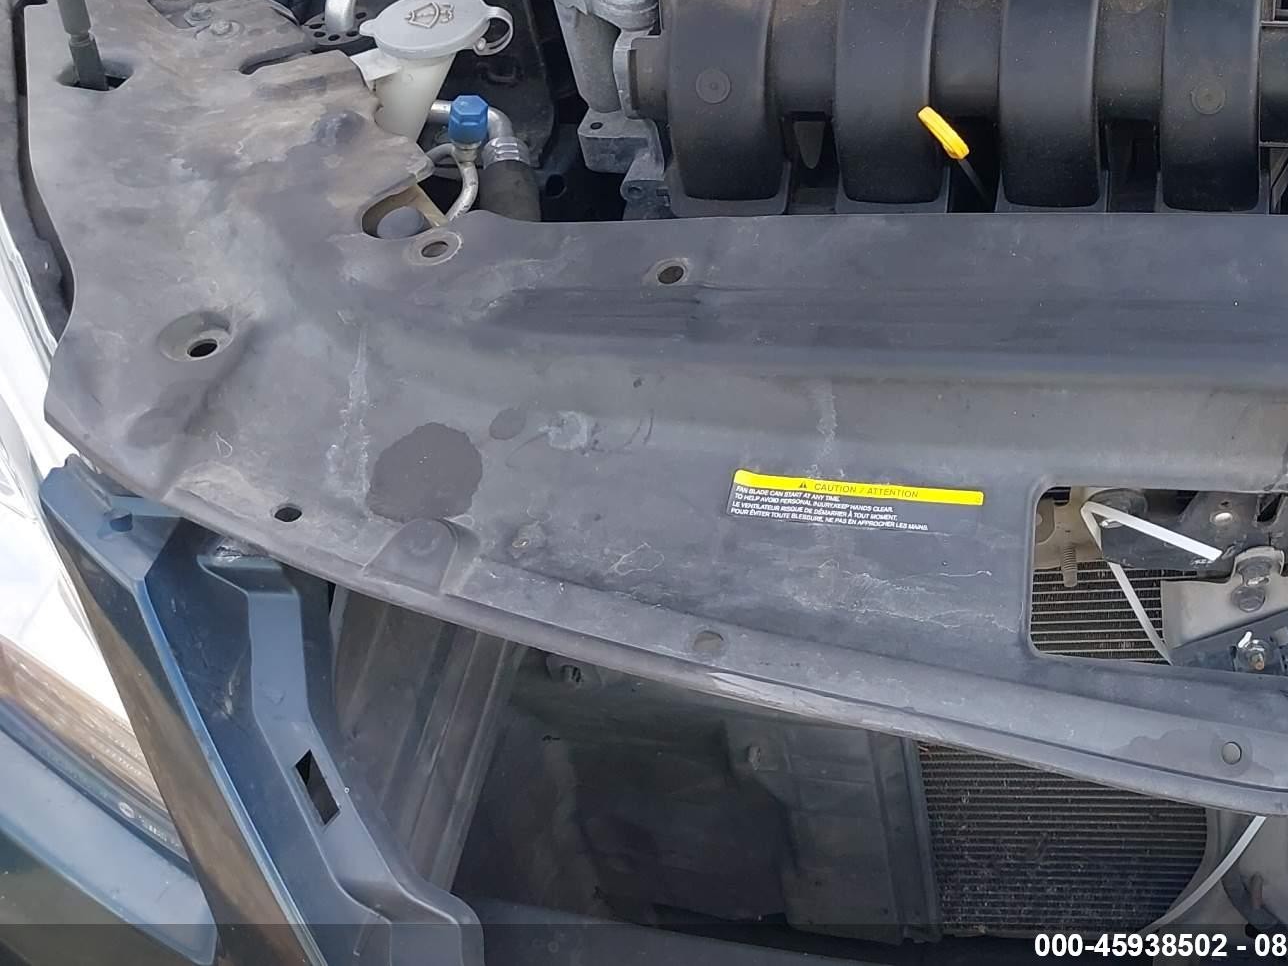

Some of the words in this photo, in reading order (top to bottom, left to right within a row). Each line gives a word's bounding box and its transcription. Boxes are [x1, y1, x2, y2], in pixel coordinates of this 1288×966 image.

[814, 483, 857, 493] CAUTION
[867, 488, 919, 498] ATTENTION
[735, 492, 743, 500] TO
[743, 494, 760, 502] HELP
[780, 497, 812, 506] PERSONAL
[849, 504, 872, 512] HANDS
[741, 501, 780, 511] VENTILATEUR
[780, 504, 803, 513] RISQUE
[771, 511, 791, 519] TOUTE
